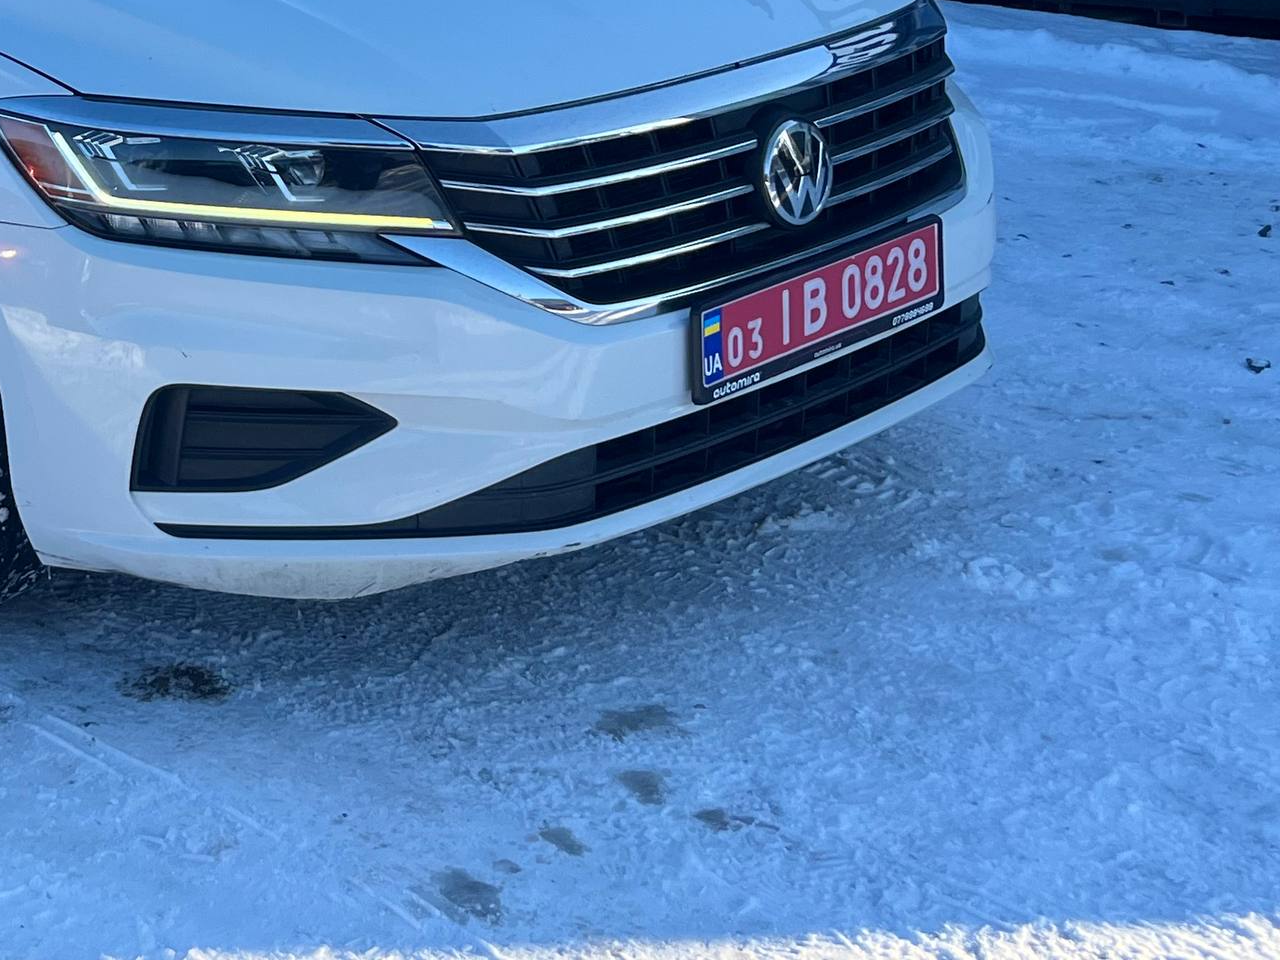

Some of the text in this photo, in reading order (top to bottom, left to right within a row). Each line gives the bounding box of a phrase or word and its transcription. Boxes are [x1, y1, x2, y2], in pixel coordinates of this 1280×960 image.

[727, 317, 763, 368] 03
[841, 238, 928, 320] 0828
[704, 353, 723, 377] UA
[713, 372, 761, 399] automira
